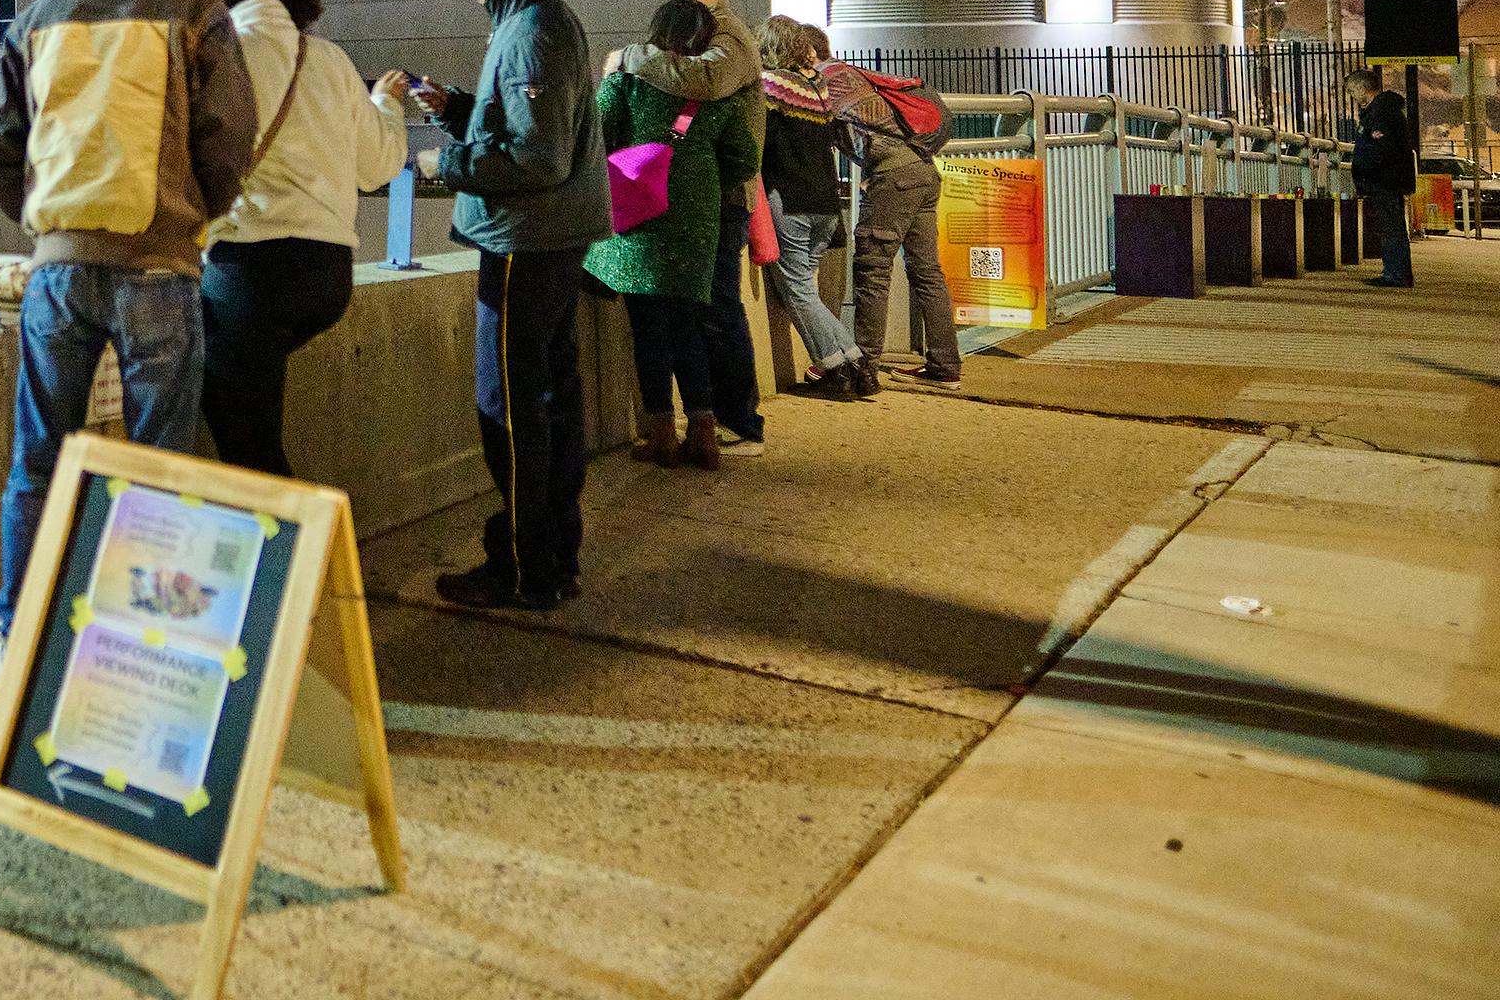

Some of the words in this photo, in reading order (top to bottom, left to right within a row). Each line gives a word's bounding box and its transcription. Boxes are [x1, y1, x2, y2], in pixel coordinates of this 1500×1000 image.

[942, 161, 989, 176] Invasive
[991, 167, 1037, 182] Species
[95, 654, 157, 686] VIEWING
[159, 674, 199, 698] DECK
[97, 632, 208, 677] PERFORMANCE
